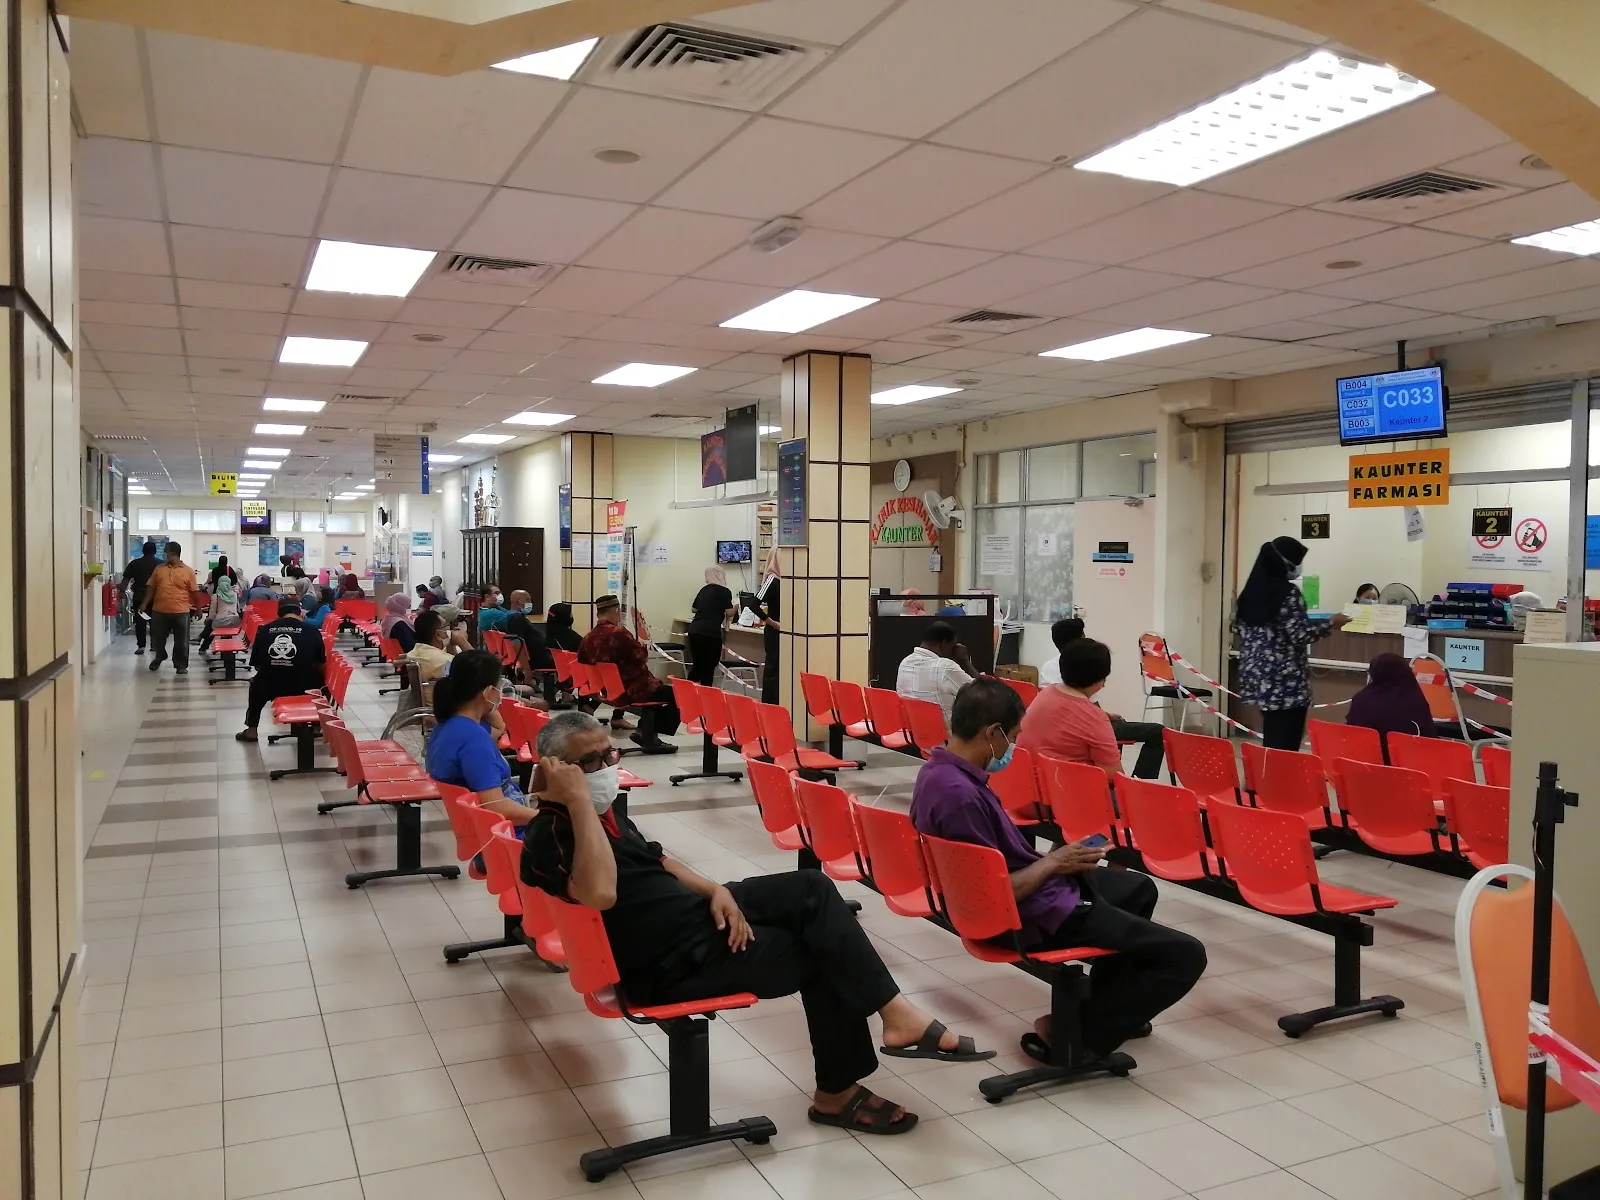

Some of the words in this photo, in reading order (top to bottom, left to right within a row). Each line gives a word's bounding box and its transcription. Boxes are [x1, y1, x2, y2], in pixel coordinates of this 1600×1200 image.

[1345, 380, 1367, 390] B004
[1347, 400, 1368, 409] C032
[1383, 386, 1434, 408] C033
[1348, 419, 1370, 429] B003
[1389, 416, 1421, 426] Kaunter
[1354, 461, 1443, 479] KAUNTER
[1353, 483, 1441, 500] FARMASI
[1311, 522, 1320, 537] 3
[1485, 517, 1498, 533] 2
[881, 525, 924, 543] KAUNTER
[1450, 643, 1480, 651] KAUNTER
